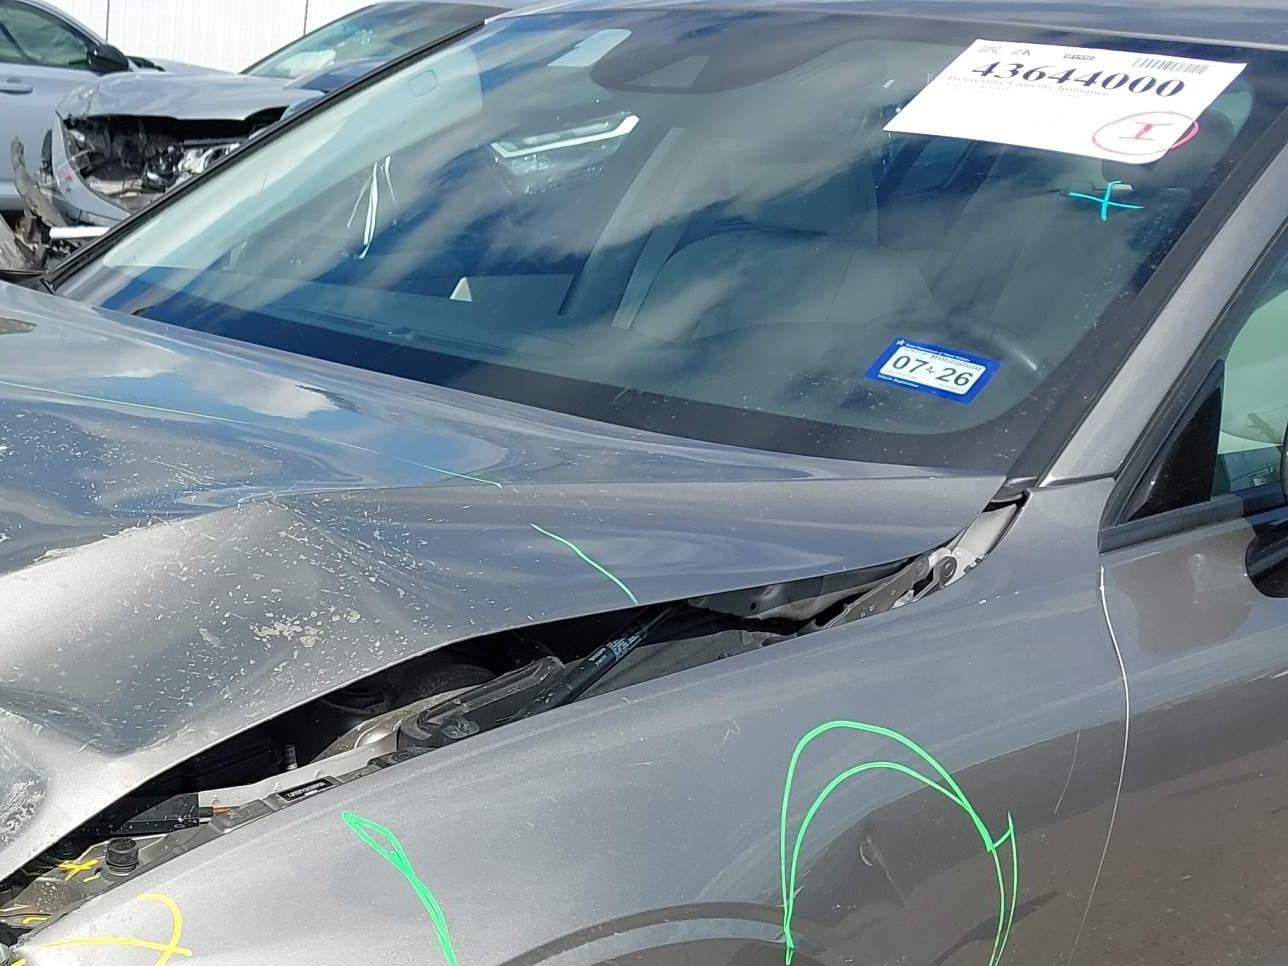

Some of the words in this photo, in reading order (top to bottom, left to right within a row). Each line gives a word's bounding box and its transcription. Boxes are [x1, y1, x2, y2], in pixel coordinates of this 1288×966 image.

[971, 60, 1186, 98] 43644000
[892, 355, 929, 373] 07
[935, 367, 974, 386] 26
